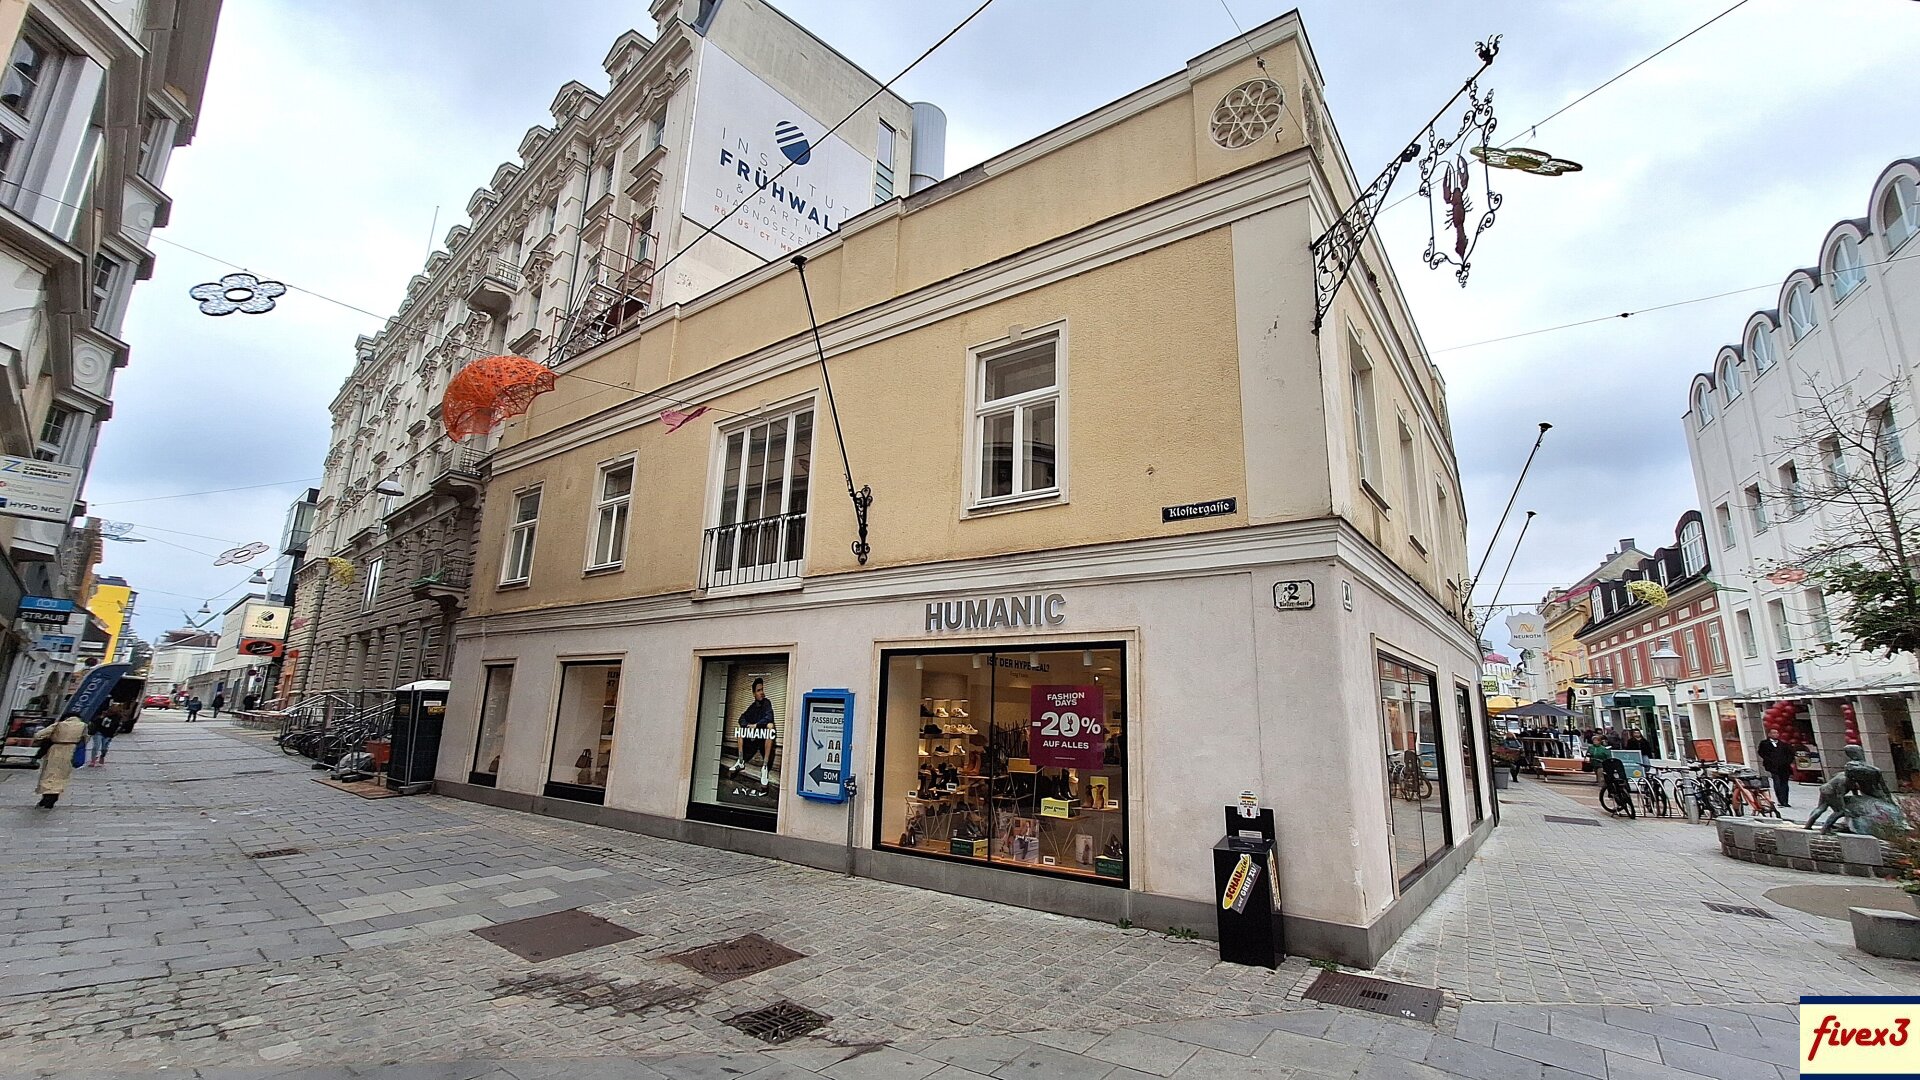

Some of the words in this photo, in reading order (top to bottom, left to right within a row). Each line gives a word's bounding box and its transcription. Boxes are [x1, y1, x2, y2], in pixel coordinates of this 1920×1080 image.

[722, 127, 850, 219] INSTITUT
[736, 183, 744, 195] &
[716, 188, 809, 247] DIAGNOSEZE
[738, 218, 749, 229] US
[760, 231, 771, 241] CT
[10, 502, 38, 511] HYPO
[1287, 583, 1300, 601] 2
[21, 611, 65, 622] STRAUB
[925, 593, 1066, 631] HUMANIC
[1000, 657, 1013, 668] DER
[1047, 692, 1085, 701] FASHION
[1055, 699, 1078, 707] DAYS
[1032, 711, 1101, 737] -20%
[734, 727, 776, 740] HUMANIC
[1043, 740, 1060, 748] AUF
[1061, 741, 1089, 750] ALLES
[823, 771, 838, 781] 50M
[1226, 870, 1243, 900] SCHAU
